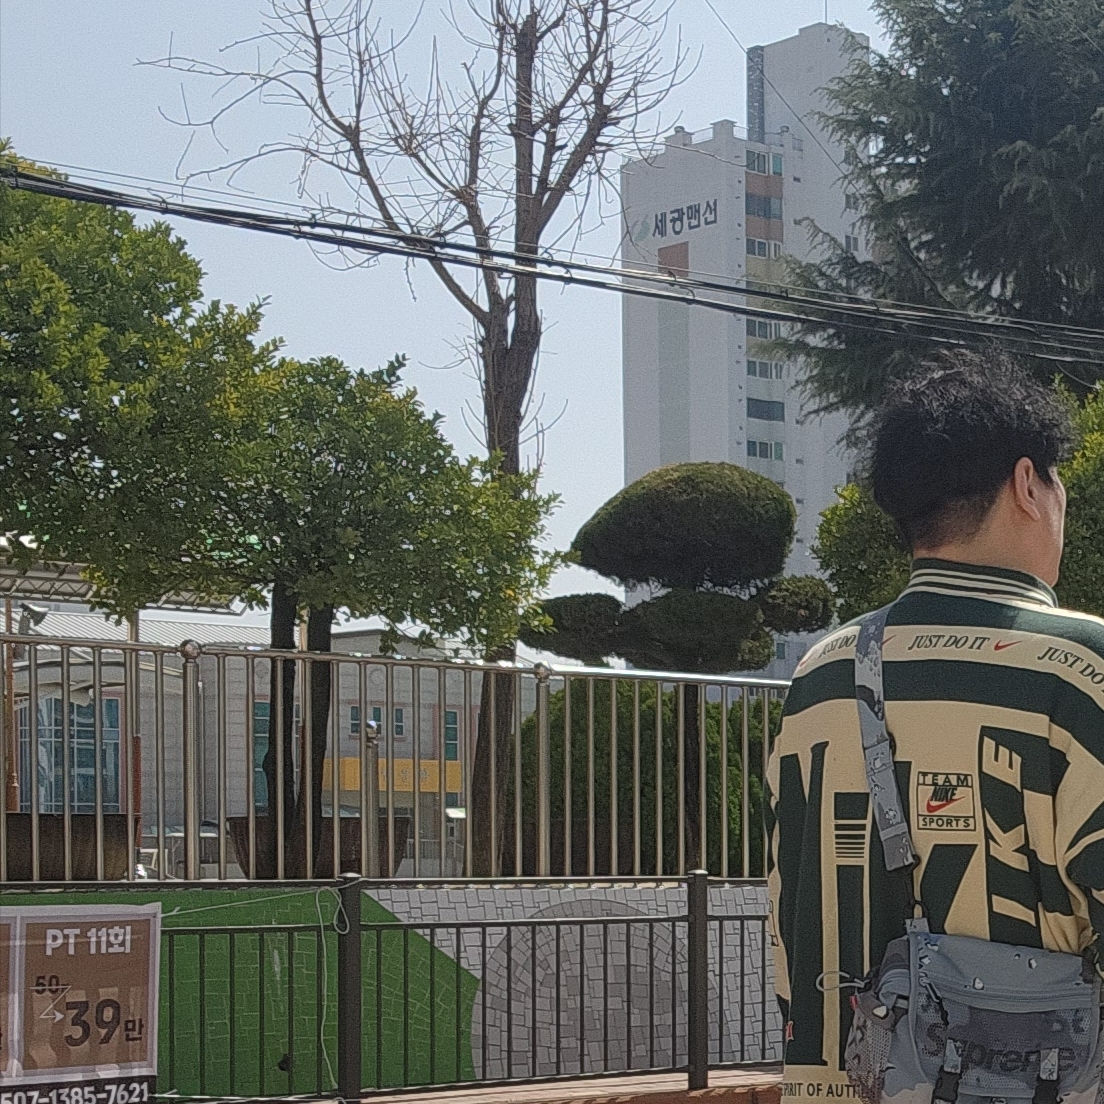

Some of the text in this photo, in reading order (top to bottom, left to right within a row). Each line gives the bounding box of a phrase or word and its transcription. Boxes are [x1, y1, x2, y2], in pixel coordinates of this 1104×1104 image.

[652, 199, 718, 238] 세광맨션
[908, 634, 991, 651] JUST DO IT
[1037, 646, 1084, 669] JUST
[921, 774, 969, 786] TEAM
[930, 785, 958, 802] NIKE
[921, 817, 971, 828] SPORTS
[45, 925, 131, 955] PT 11회
[781, 1082, 804, 1097] PIRIT
[806, 1082, 823, 1097] OF
